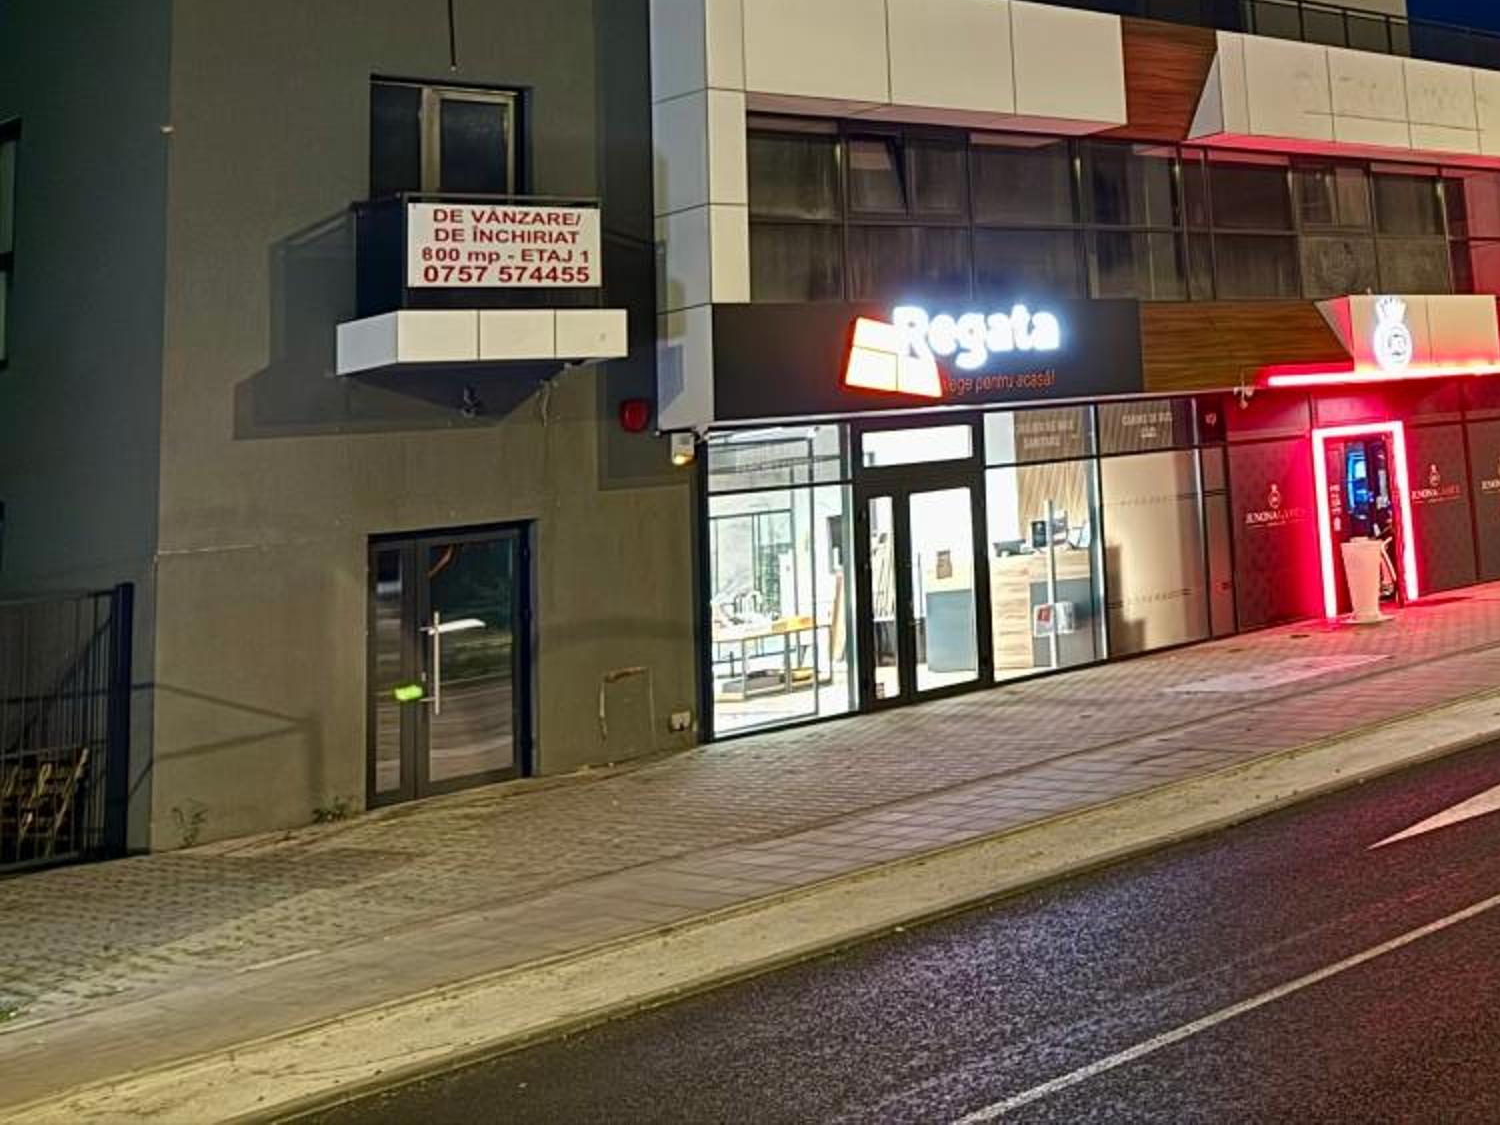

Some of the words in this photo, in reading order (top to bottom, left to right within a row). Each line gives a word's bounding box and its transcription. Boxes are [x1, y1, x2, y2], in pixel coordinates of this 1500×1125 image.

[433, 208, 464, 223] DE
[434, 228, 465, 242] DE
[473, 225, 580, 244] ÎNCHIRIAT
[467, 250, 501, 265] mp
[521, 248, 573, 263] ETAJ
[580, 250, 589, 263] 1
[423, 265, 488, 283] 0757
[498, 266, 590, 283] 574455
